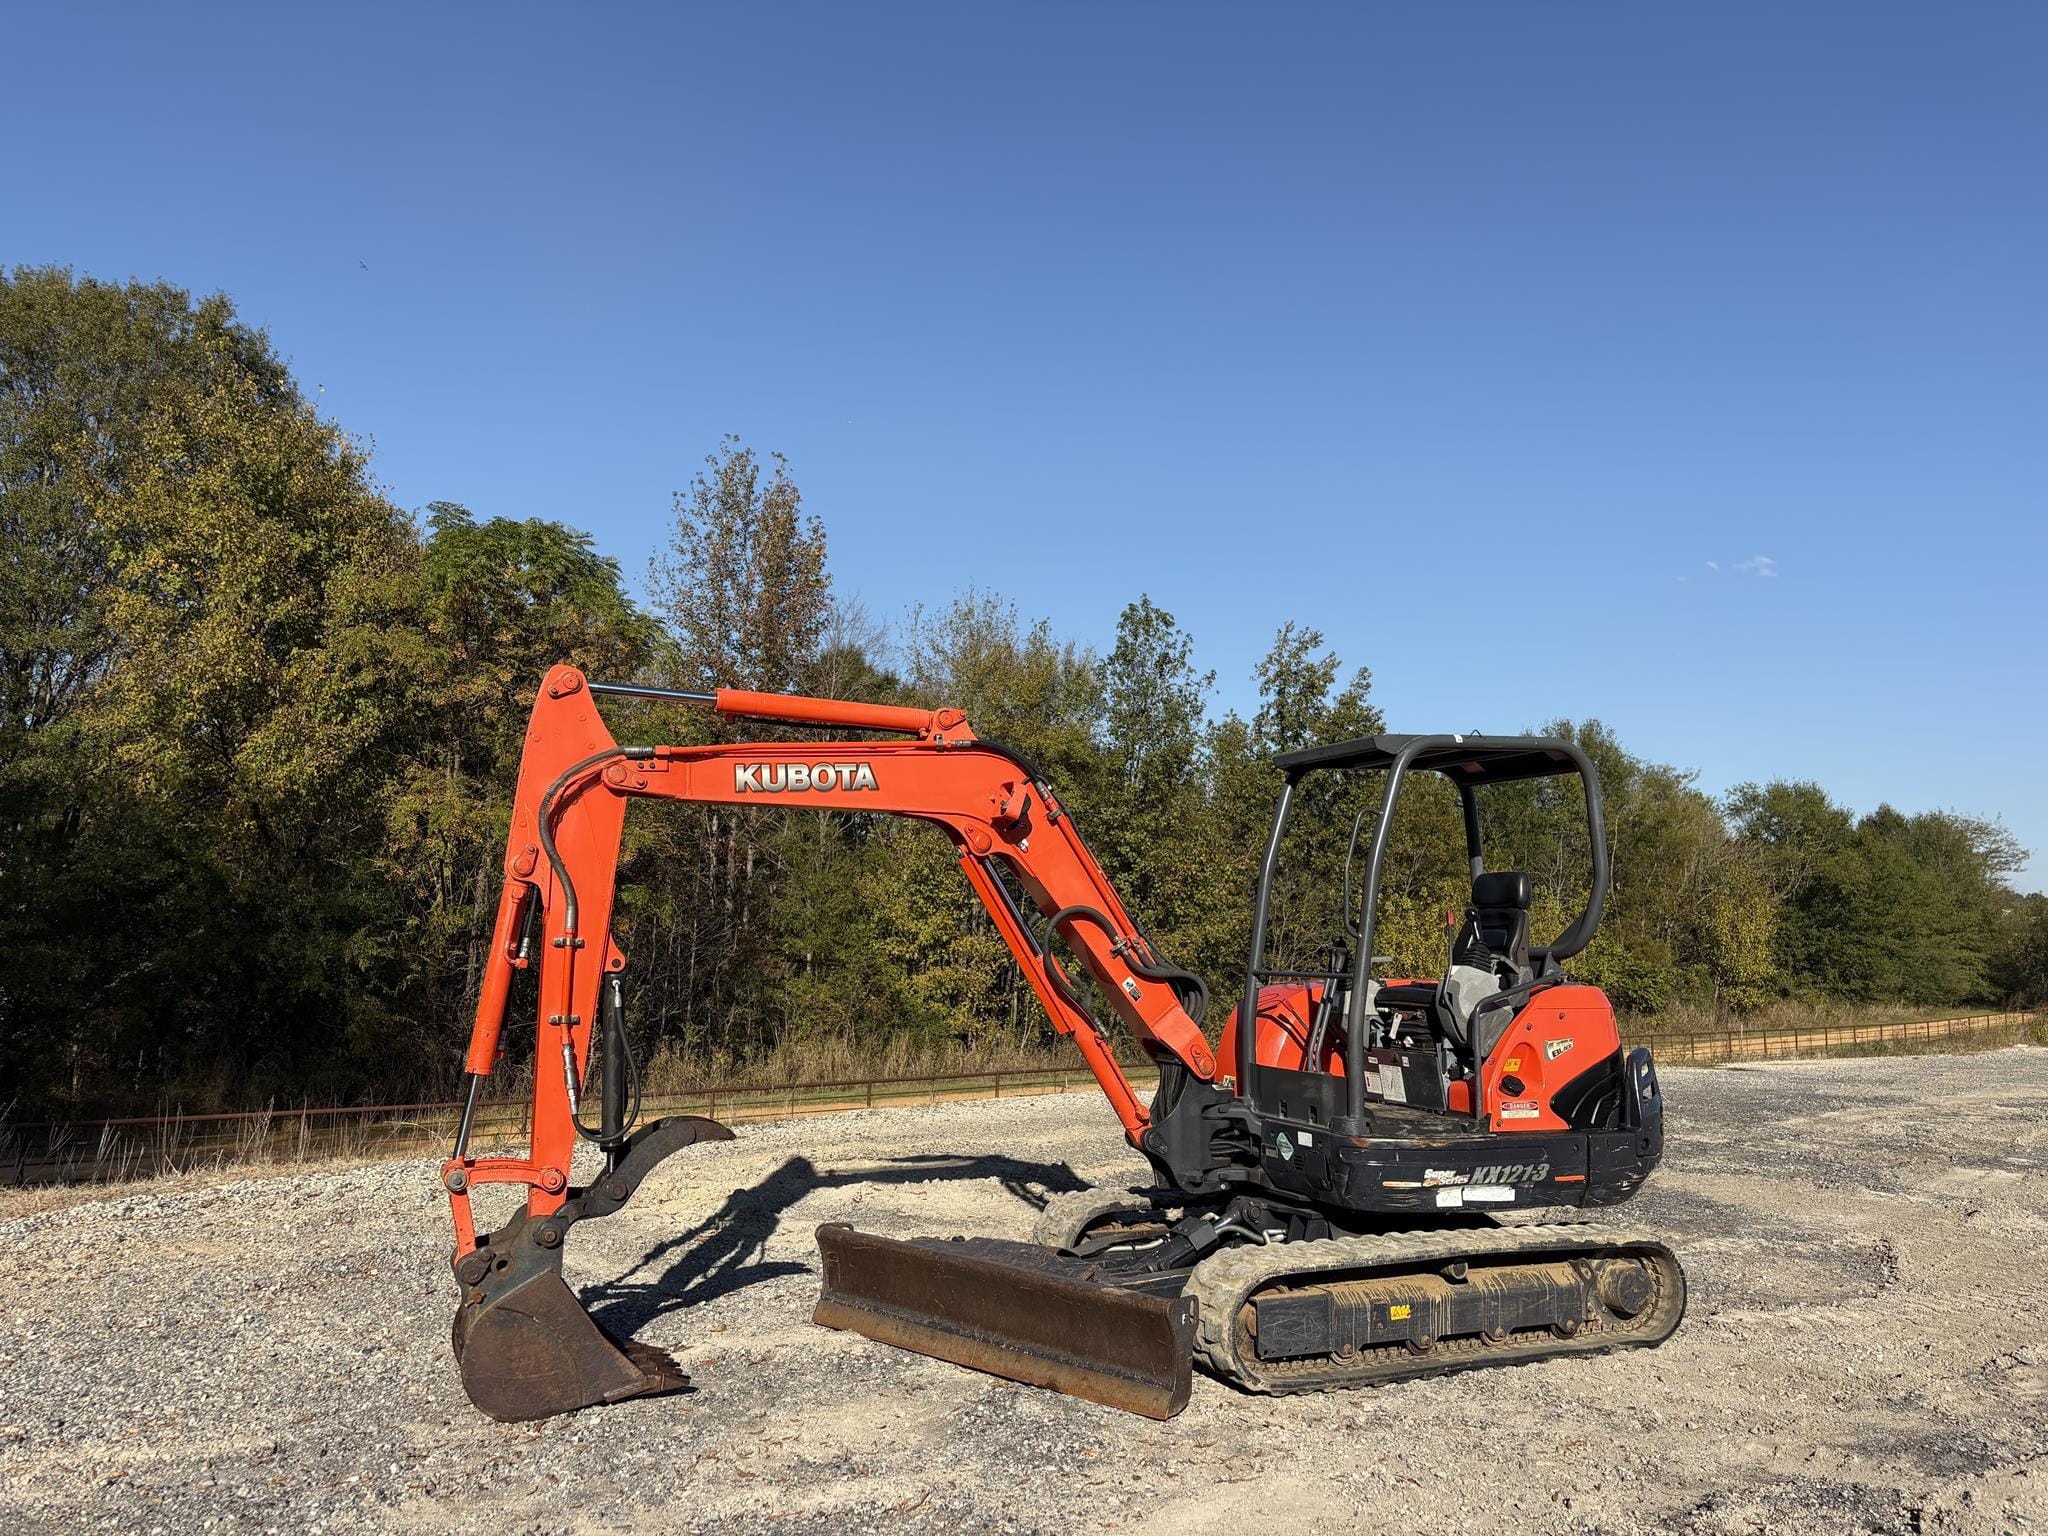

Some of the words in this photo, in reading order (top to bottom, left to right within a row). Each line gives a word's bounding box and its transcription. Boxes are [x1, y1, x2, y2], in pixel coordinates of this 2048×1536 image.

[735, 762, 880, 793] KUBOTA
[1424, 1168, 1457, 1180] Super
[1439, 1175, 1470, 1185] Series
[1469, 1163, 1550, 1184] KX121-3
